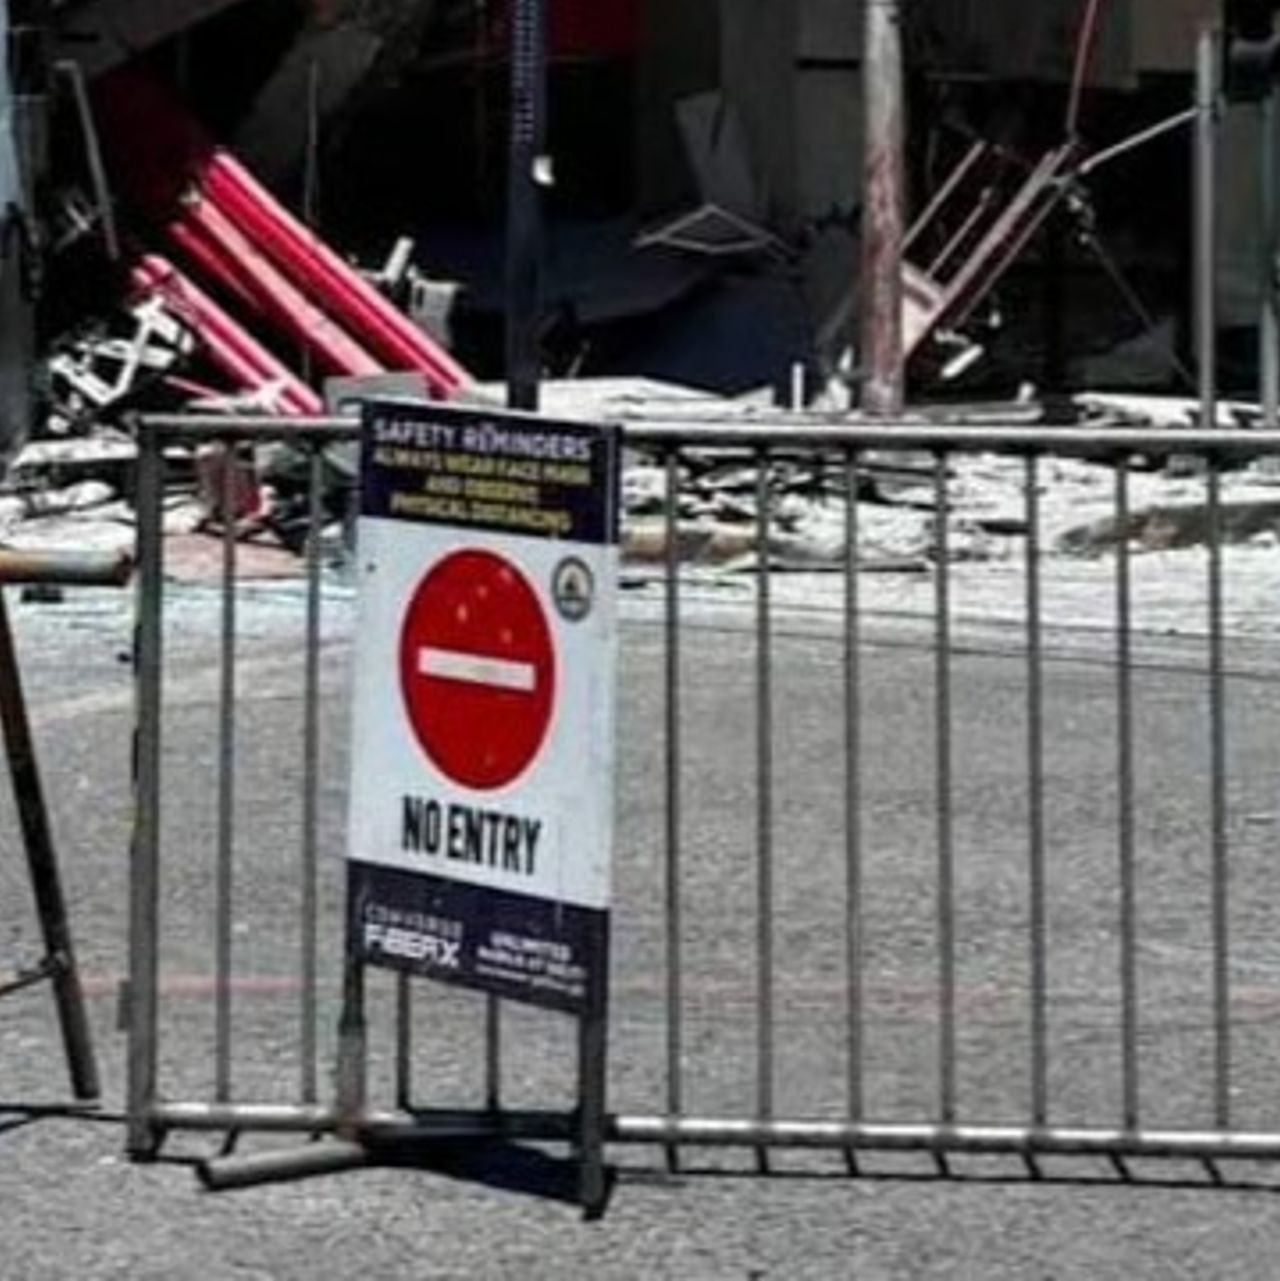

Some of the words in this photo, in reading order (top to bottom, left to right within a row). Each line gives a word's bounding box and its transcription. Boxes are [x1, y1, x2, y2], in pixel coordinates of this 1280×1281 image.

[374, 419, 455, 448] SAFETY
[462, 424, 592, 459] REMINDERS
[401, 794, 442, 855] NO
[447, 803, 542, 876] ENTRY
